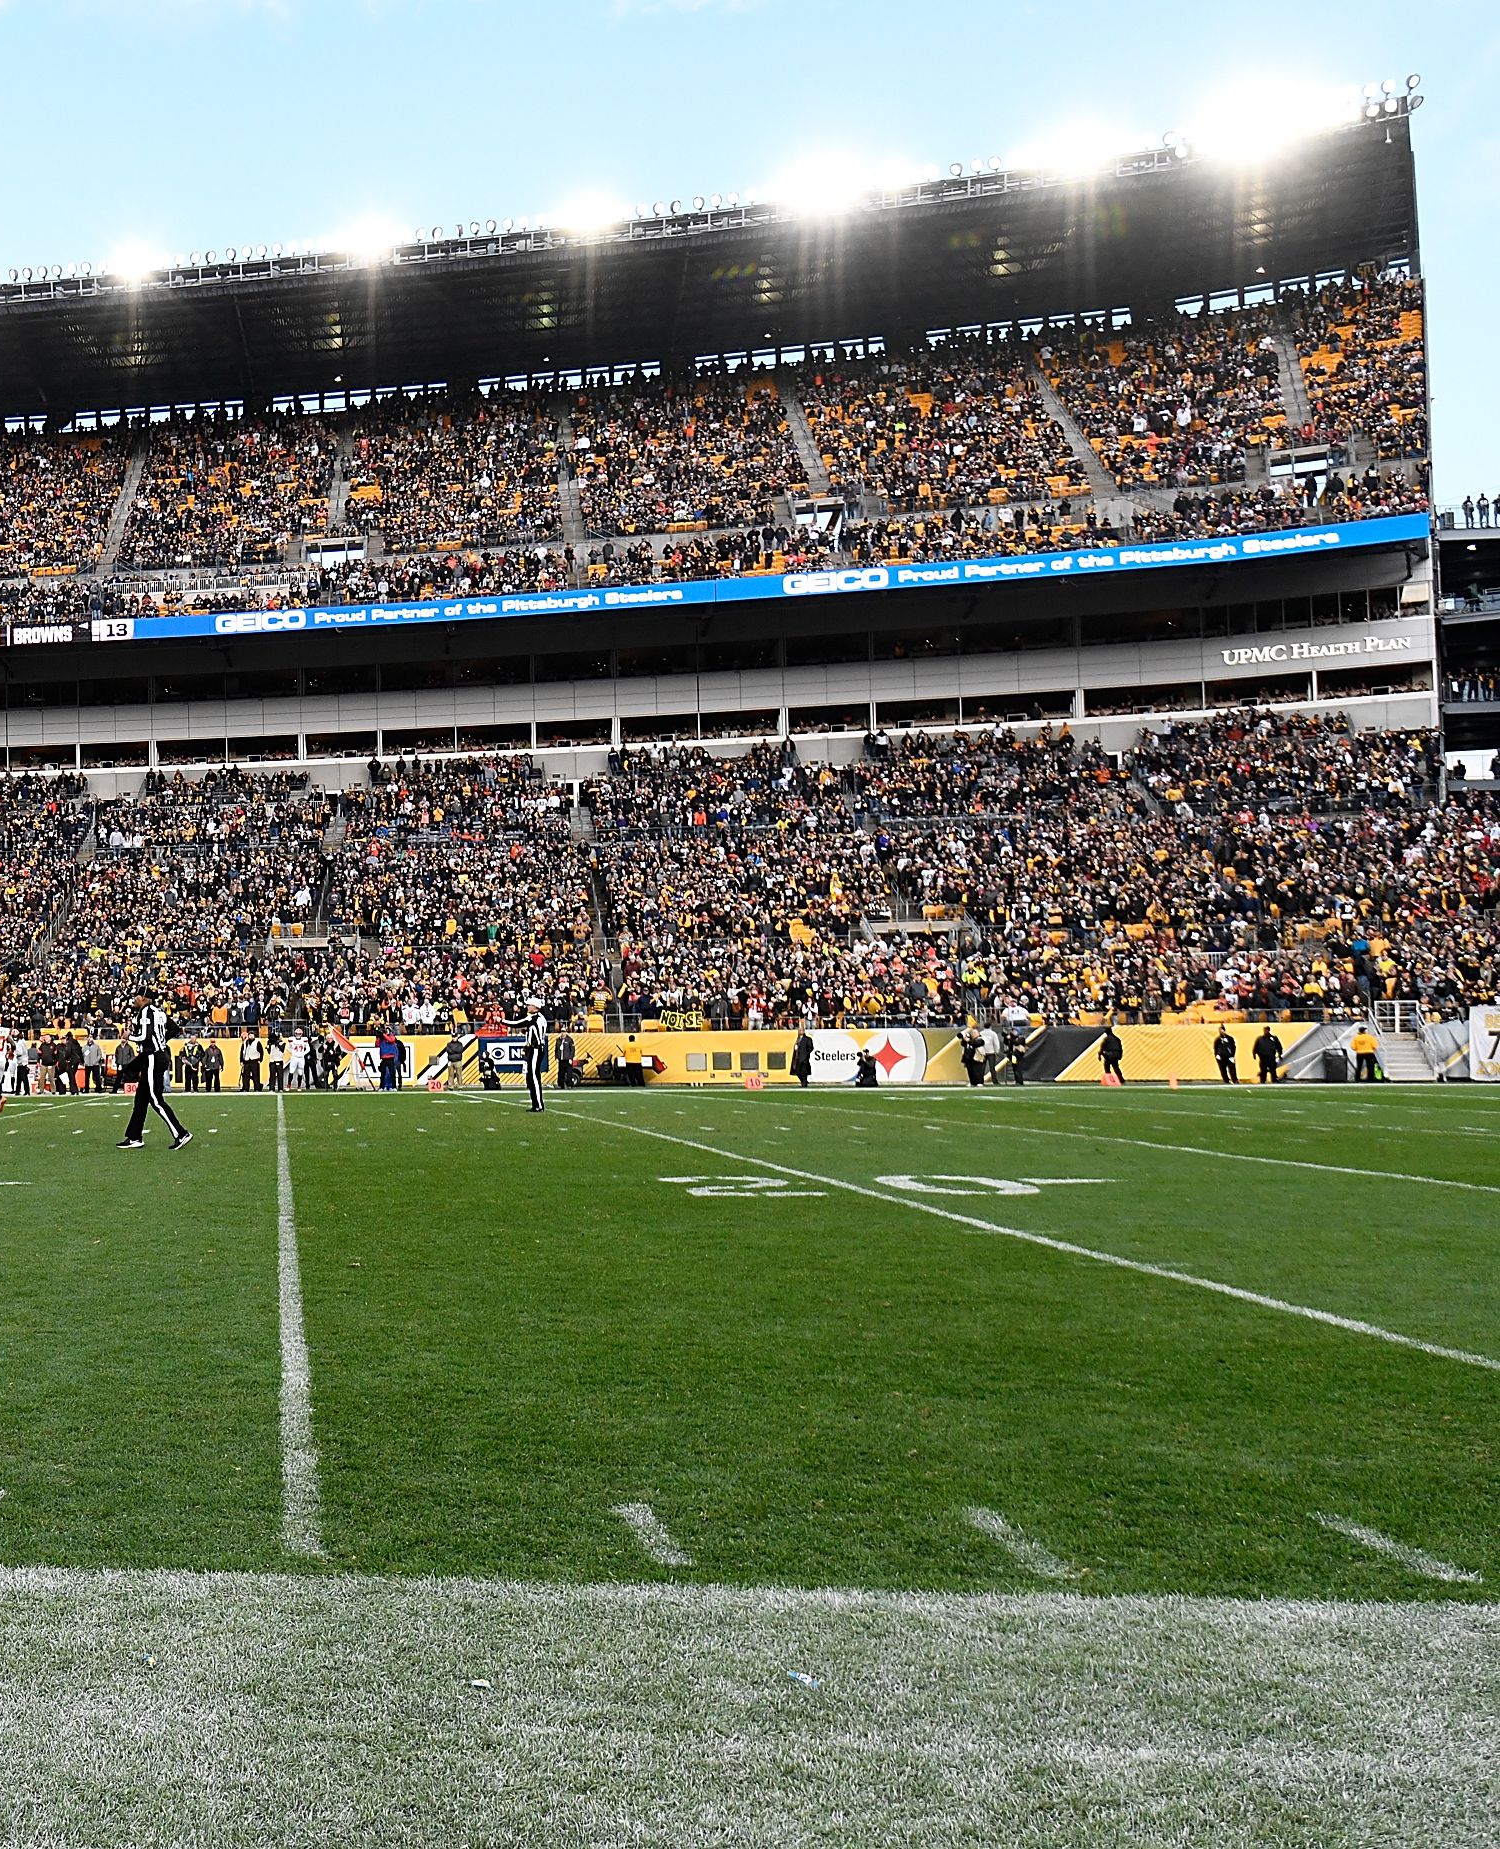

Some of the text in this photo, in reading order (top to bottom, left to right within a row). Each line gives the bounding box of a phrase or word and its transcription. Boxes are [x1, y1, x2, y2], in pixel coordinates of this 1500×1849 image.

[783, 532, 1340, 595] GEICO Proud Partner of the Pittsburgh Steelers
[215, 590, 683, 633] GEICO Proud Partner of the Pittsburgh Steelers
[13, 625, 73, 644] BROWNS
[106, 624, 127, 637] 13
[1221, 644, 1287, 666] UPMC
[440, 1011, 449, 1020] 43
[814, 1050, 856, 1061] Steelers
[430, 1080, 442, 1090] 20
[749, 1077, 761, 1087] 10
[127, 1084, 137, 1093] 30
